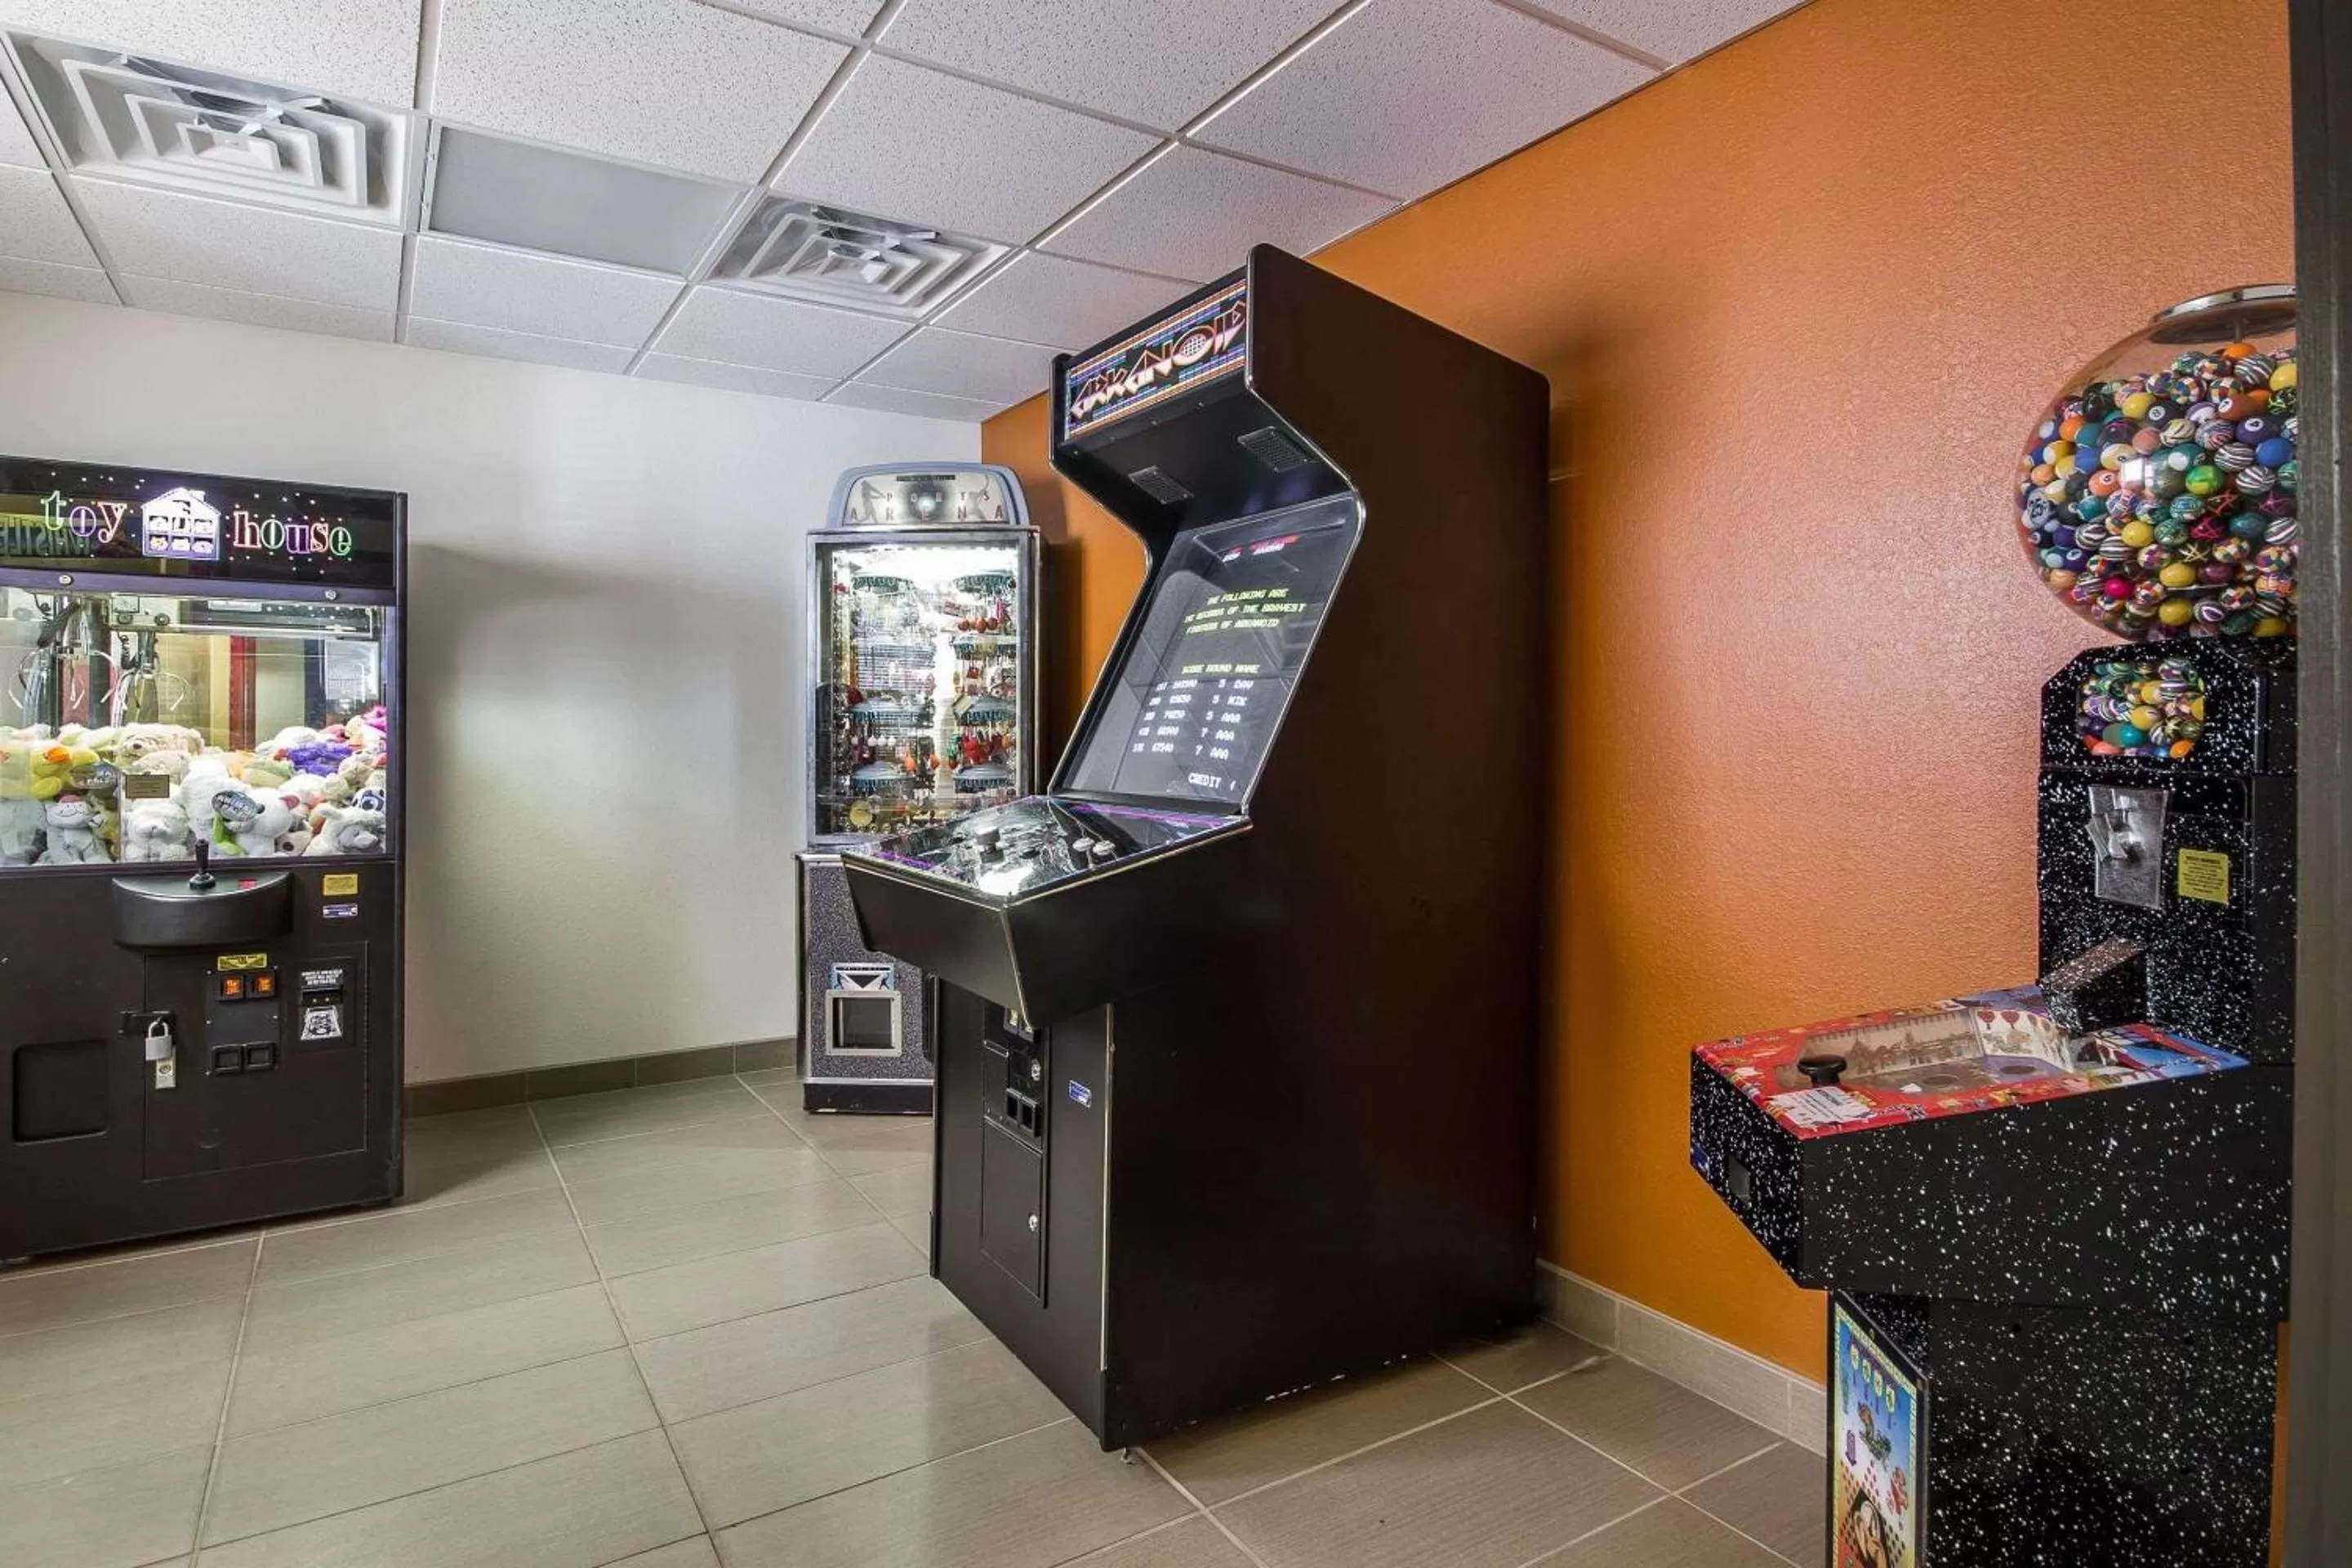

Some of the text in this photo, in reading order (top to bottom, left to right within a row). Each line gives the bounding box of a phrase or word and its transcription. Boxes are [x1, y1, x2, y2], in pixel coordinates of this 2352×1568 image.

[850, 505, 1004, 521] ARENA
[41, 490, 352, 556] toy house
[1187, 773, 1223, 789] CREDIT
